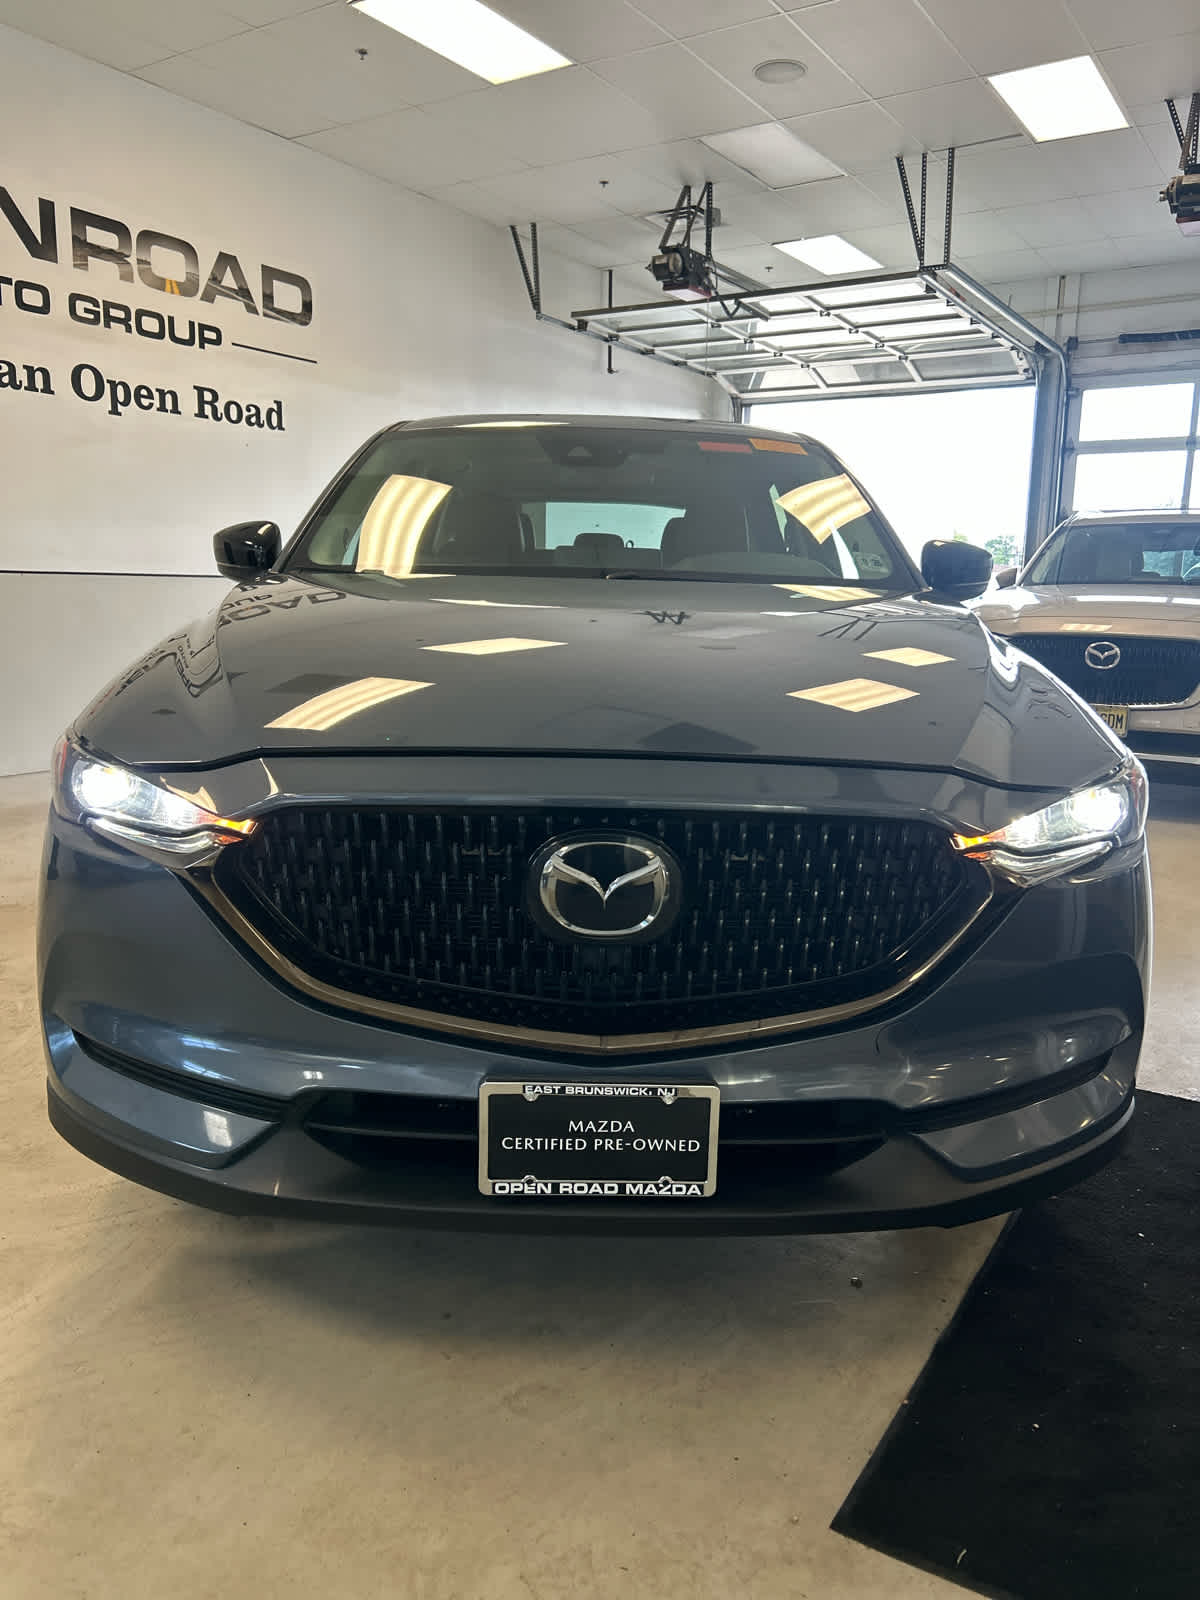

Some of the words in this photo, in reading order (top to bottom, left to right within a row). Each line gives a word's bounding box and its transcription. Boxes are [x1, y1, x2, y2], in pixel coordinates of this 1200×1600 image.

[68, 292, 223, 349] GROUP
[71, 363, 182, 417] Open
[193, 385, 285, 431] Road
[525, 1085, 561, 1096] EAST
[657, 1088, 676, 1097] NJ
[568, 1120, 635, 1133] MAZDA
[501, 1137, 587, 1151] CERTIFIED
[594, 1138, 701, 1152] PRE-OWNED
[494, 1182, 552, 1195] OPEN
[559, 1182, 619, 1196] ROAD
[625, 1183, 702, 1196] MAZDA
